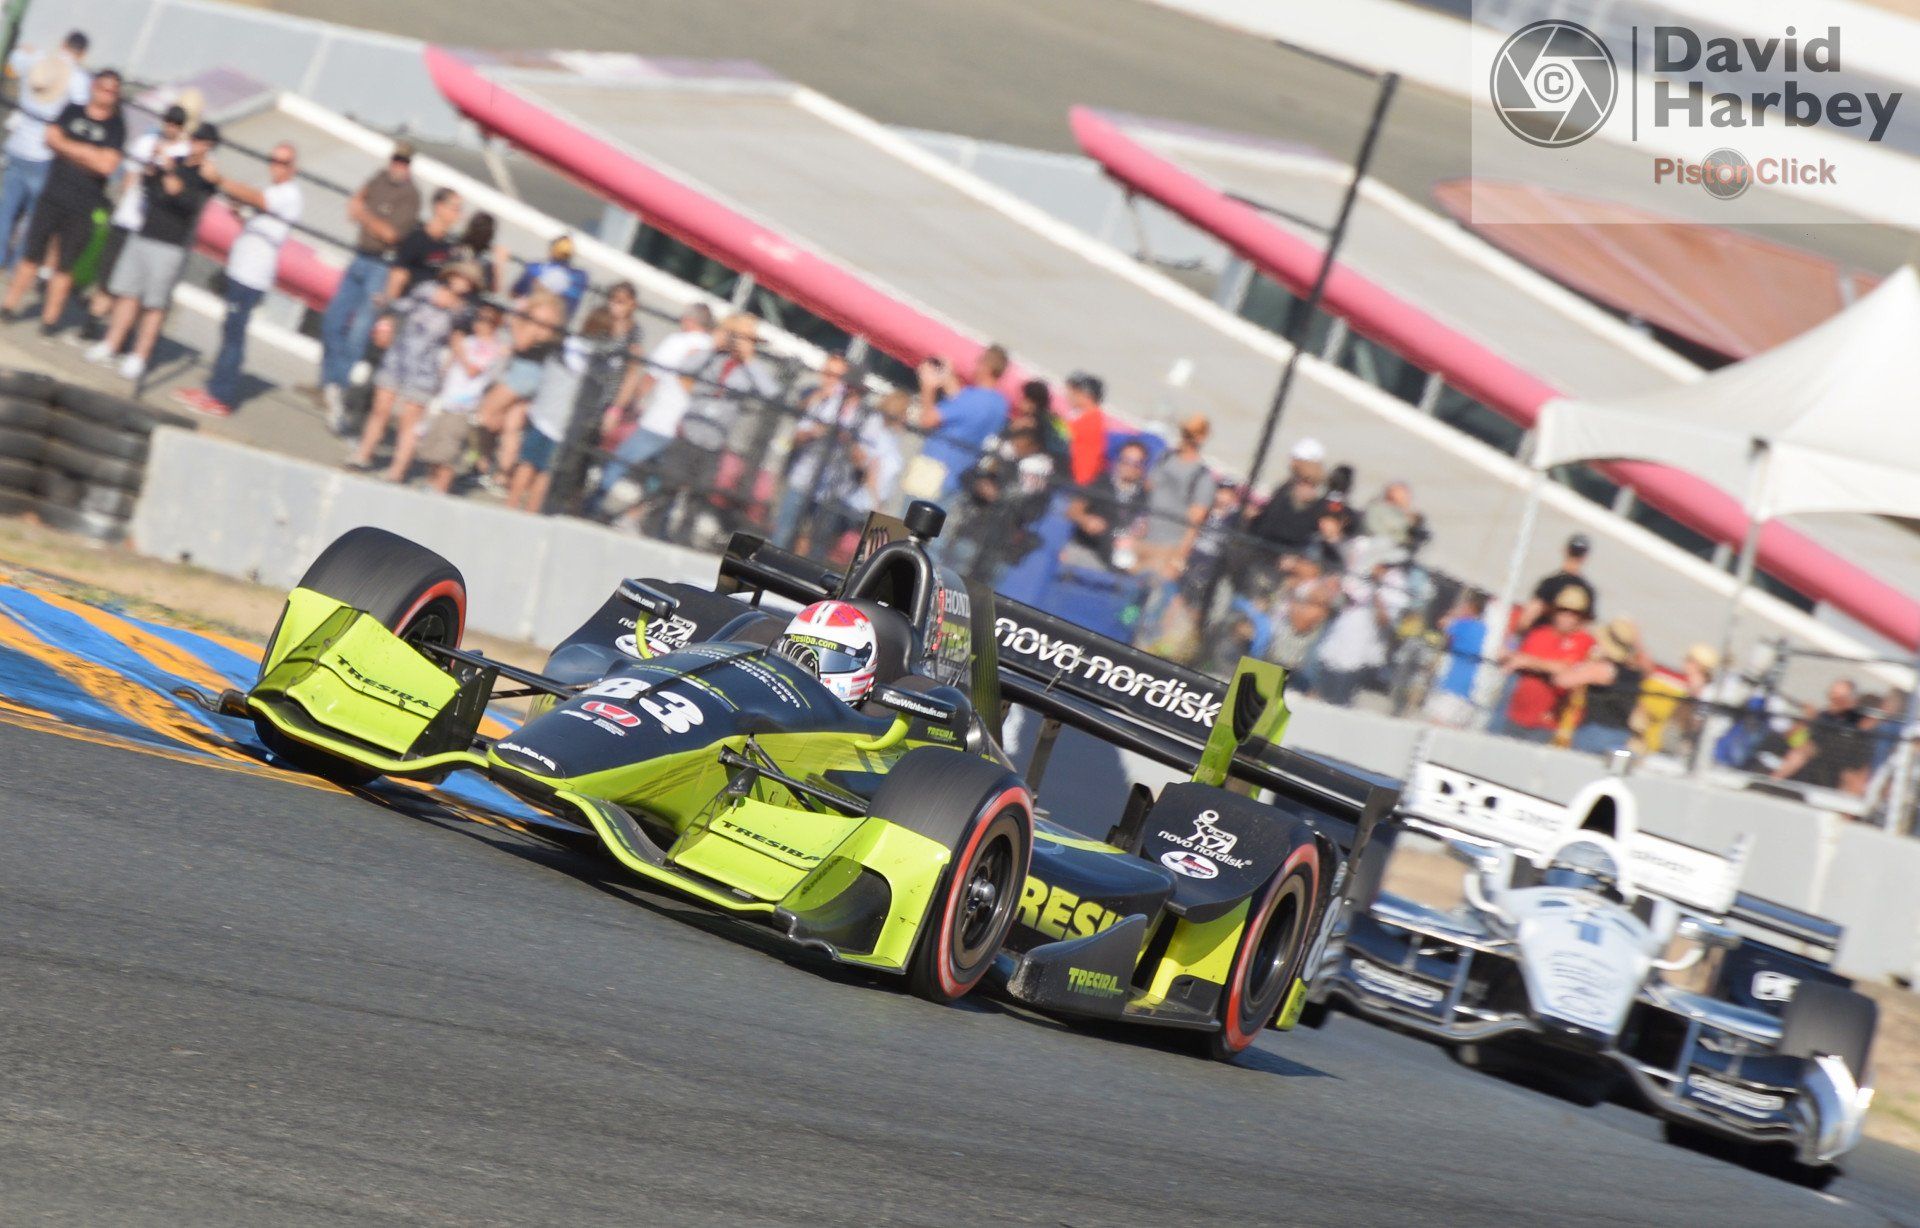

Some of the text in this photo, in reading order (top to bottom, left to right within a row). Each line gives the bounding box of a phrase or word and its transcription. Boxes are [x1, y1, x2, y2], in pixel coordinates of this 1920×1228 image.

[945, 588, 971, 619] HOND
[618, 617, 691, 649] noo nord
[337, 654, 439, 710] TRESIBA
[994, 617, 1081, 671] novo
[1083, 655, 1223, 728] nordisk
[582, 677, 704, 735] 83
[722, 820, 822, 861] TRESIBA
[1158, 830, 1193, 849] novo
[1194, 845, 1246, 869] nordisk
[1016, 875, 1123, 941] RESI
[1067, 967, 1124, 998] TRESIBA
